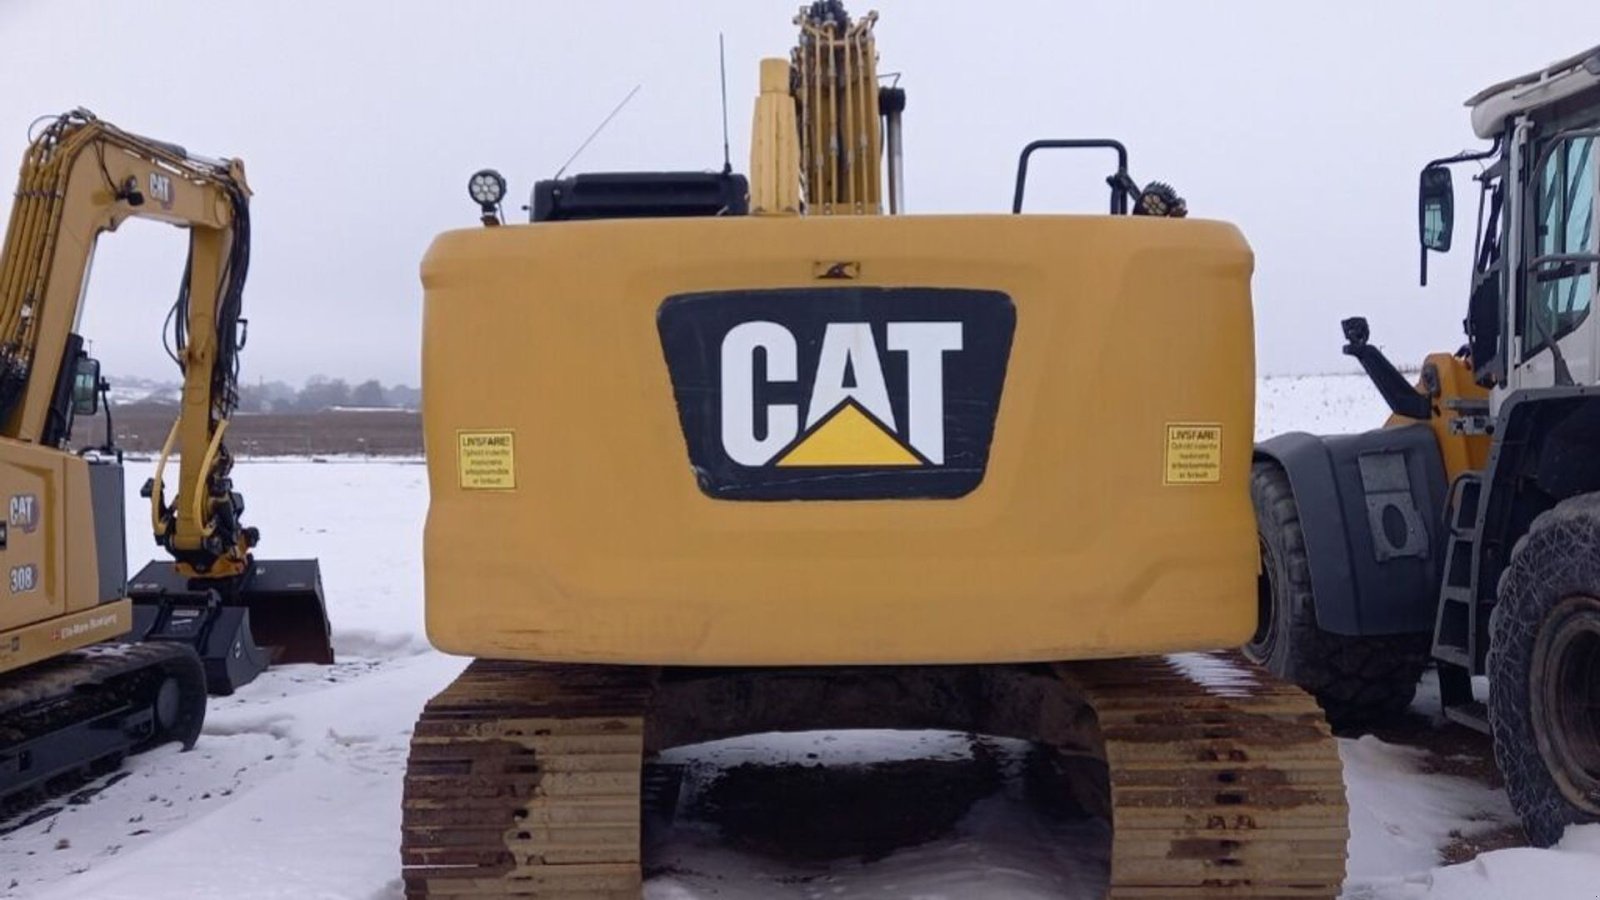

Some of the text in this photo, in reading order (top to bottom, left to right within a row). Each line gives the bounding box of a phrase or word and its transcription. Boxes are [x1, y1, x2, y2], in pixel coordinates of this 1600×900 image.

[150, 173, 170, 202] CAT
[721, 320, 963, 466] CAT
[10, 496, 34, 525] CAT
[10, 567, 33, 592] 308
